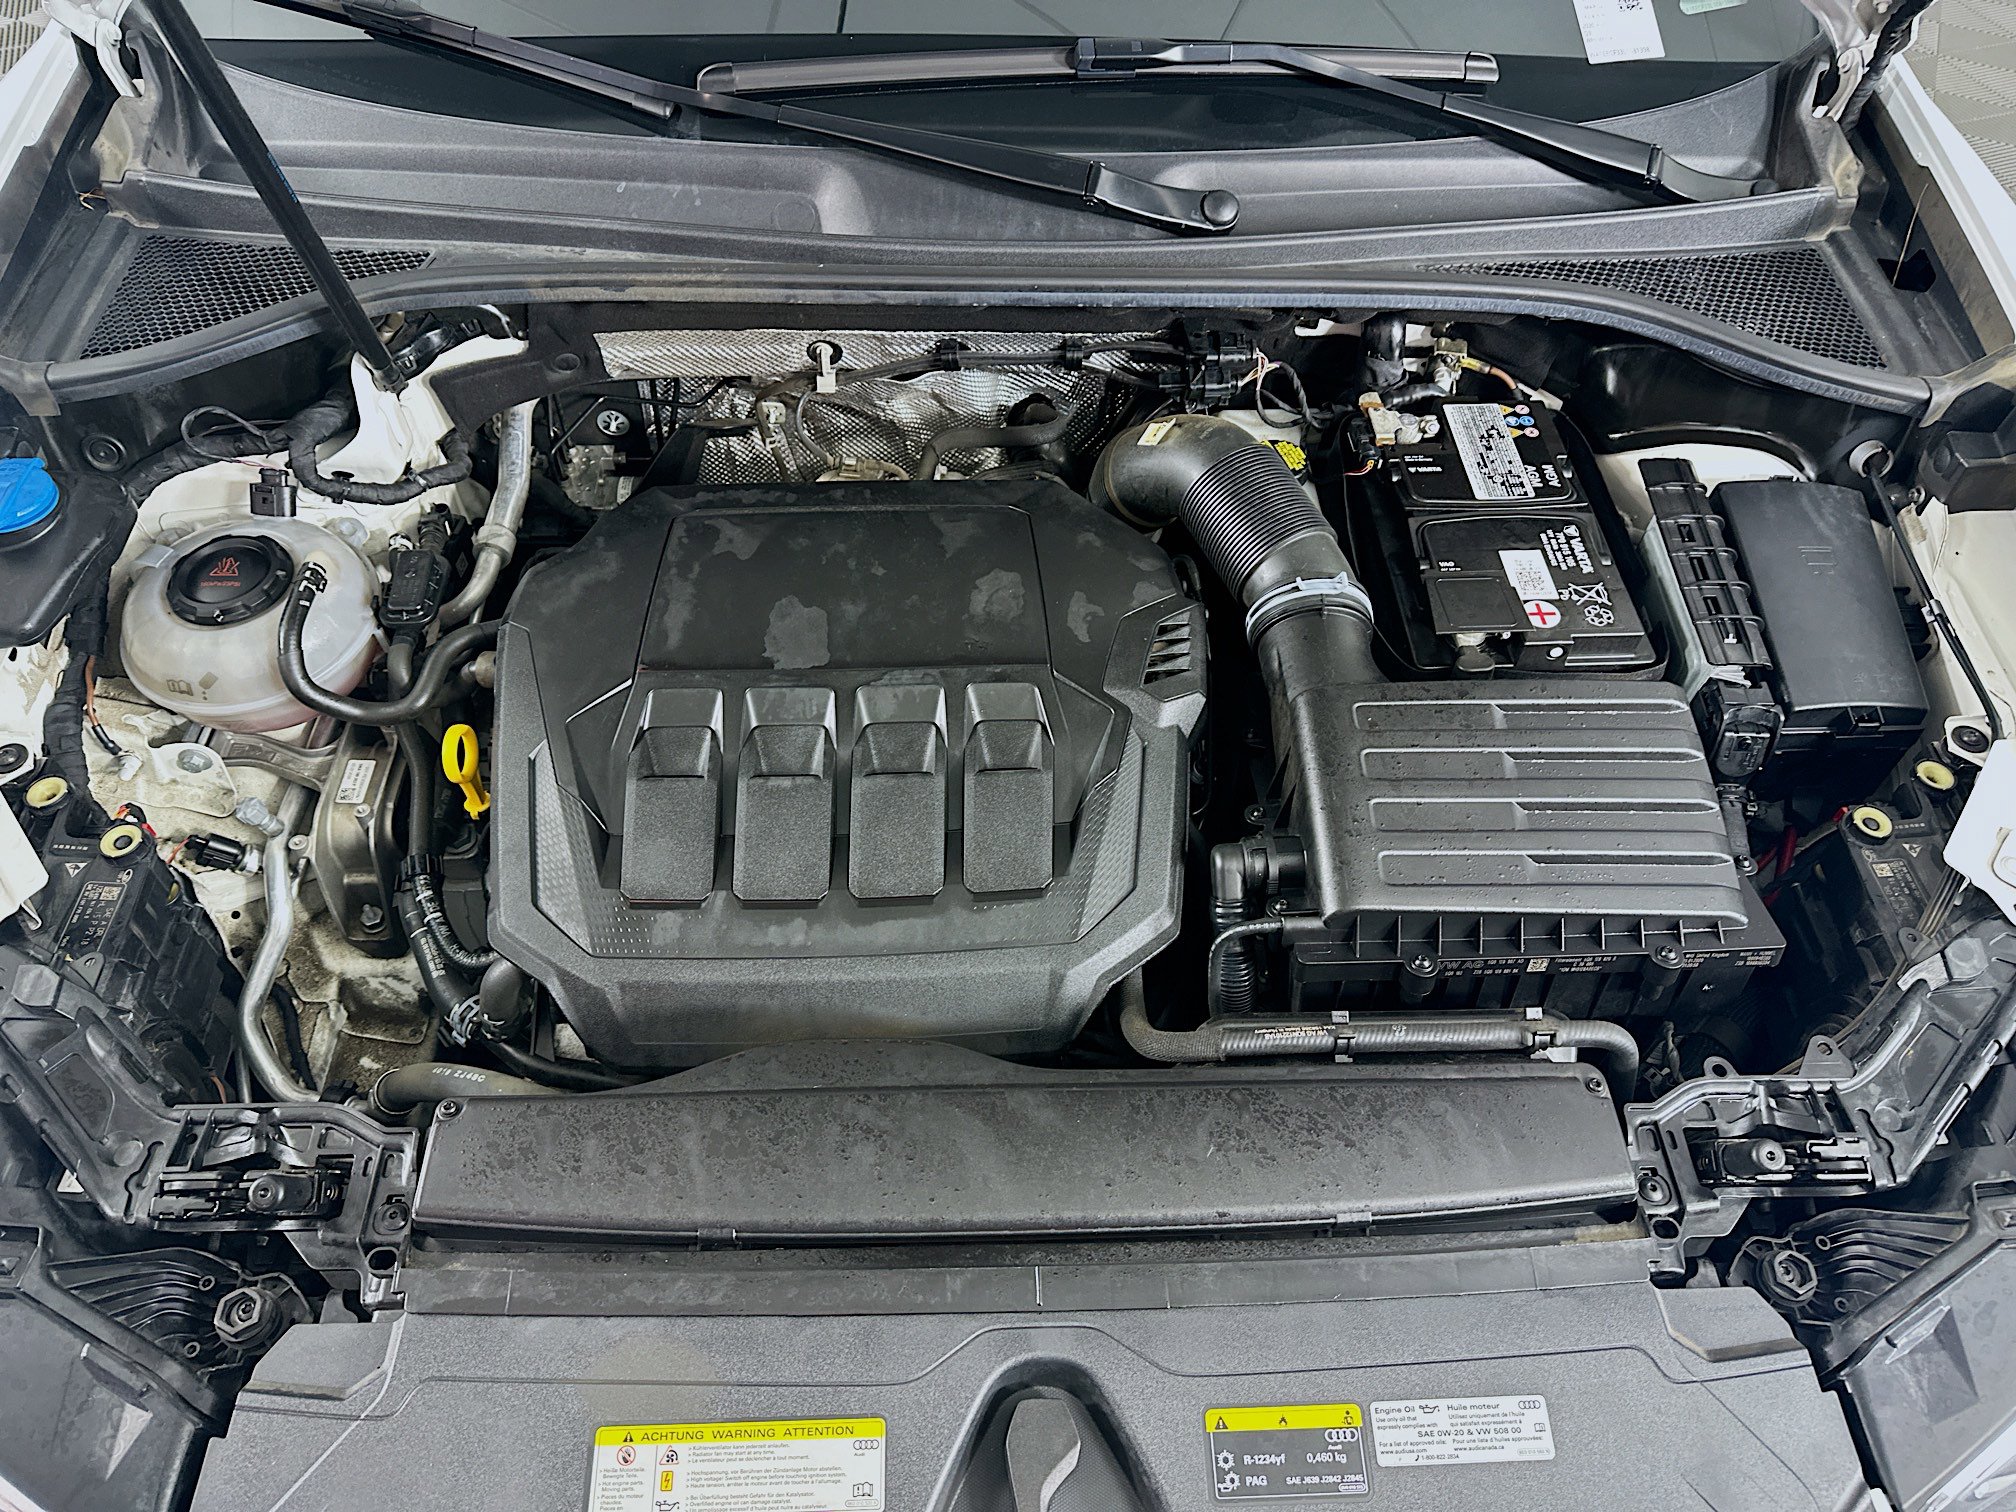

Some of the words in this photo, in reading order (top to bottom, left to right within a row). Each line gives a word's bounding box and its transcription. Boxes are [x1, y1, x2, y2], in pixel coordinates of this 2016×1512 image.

[1524, 464, 1543, 487] AGM
[1541, 464, 1561, 487] AGM
[1570, 537, 1594, 574] VARTA
[1375, 1407, 1402, 1415] Engine
[641, 1430, 704, 1442] ACHTUNG
[712, 1428, 776, 1439] WARNING
[783, 1426, 854, 1437] ATTENTION
[1243, 1454, 1285, 1466] R-1234yf
[1307, 1453, 1333, 1464] 0,460
[1335, 1452, 1347, 1463] kg
[1246, 1476, 1267, 1486] PAG
